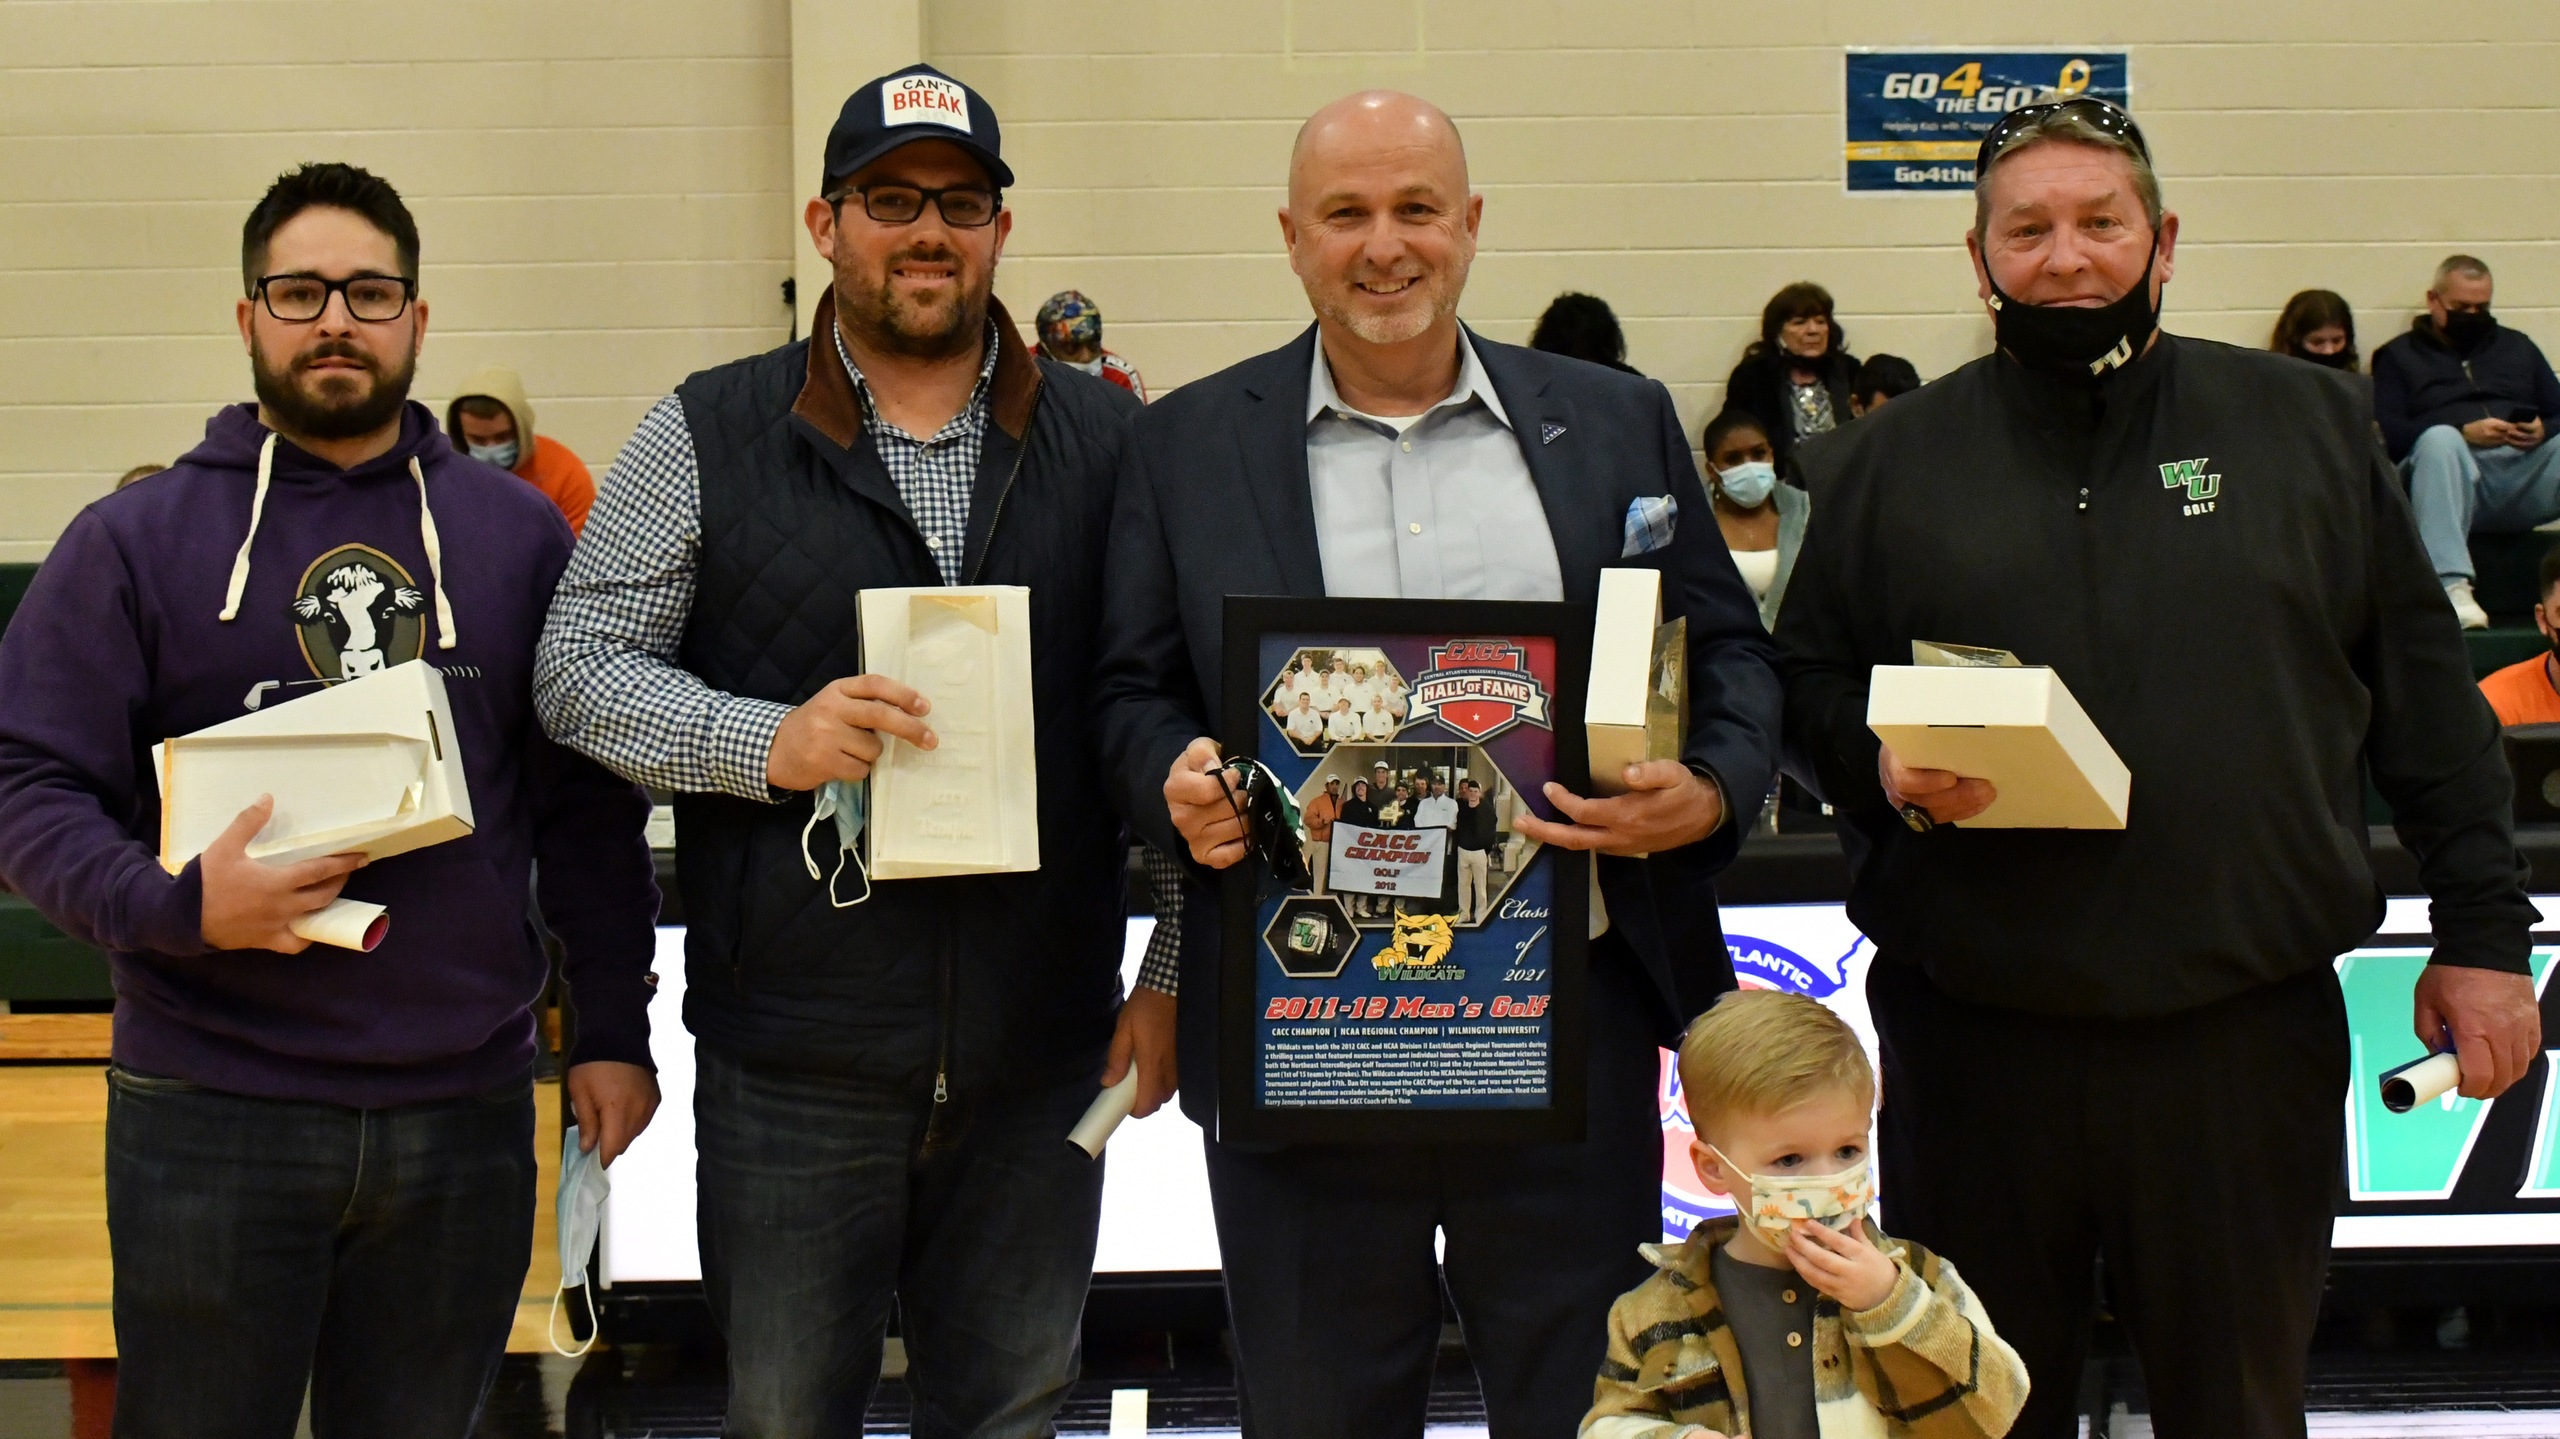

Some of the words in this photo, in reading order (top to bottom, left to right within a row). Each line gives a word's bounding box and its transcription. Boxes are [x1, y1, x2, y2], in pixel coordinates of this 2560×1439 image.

[902, 79, 952, 93] CAN'T
[893, 90, 963, 116] BREAK
[1935, 98, 1976, 113] THE
[2182, 501, 2216, 517] GOLF
[1446, 642, 1507, 661] CACC
[1424, 672, 1445, 681] CENTRAL
[1445, 669, 1467, 677] ATLANTIC
[1497, 670, 1528, 680] CONFERENCE
[1421, 680, 1466, 702] HALL
[1466, 683, 1482, 694] OF
[1482, 679, 1531, 702] FAME
[1357, 832, 1421, 850] CACC
[1344, 847, 1432, 864] CHAMPION
[1373, 868, 1401, 878] GOLF
[1375, 881, 1397, 891] 2012
[1500, 898, 1550, 920] Class
[1515, 925, 1547, 965] of
[1378, 964, 1466, 981] WILDCATS
[1502, 968, 1546, 982] 2021
[1726, 945, 1813, 990] LANTIC
[1264, 996, 1389, 1020] 2011-12
[1390, 995, 1484, 1018] Men's
[1489, 995, 1551, 1018] Golf
[1272, 1028, 1289, 1036] CACC
[1291, 1028, 1330, 1036] CHAMPION
[1340, 1027, 1360, 1036] NCAA
[1362, 1027, 1397, 1035] REGIONAL
[1400, 1026, 1438, 1035] CHAMPION
[1448, 1026, 1496, 1035] WILMINGTON
[1497, 1026, 1540, 1034] UNIVERSITY
